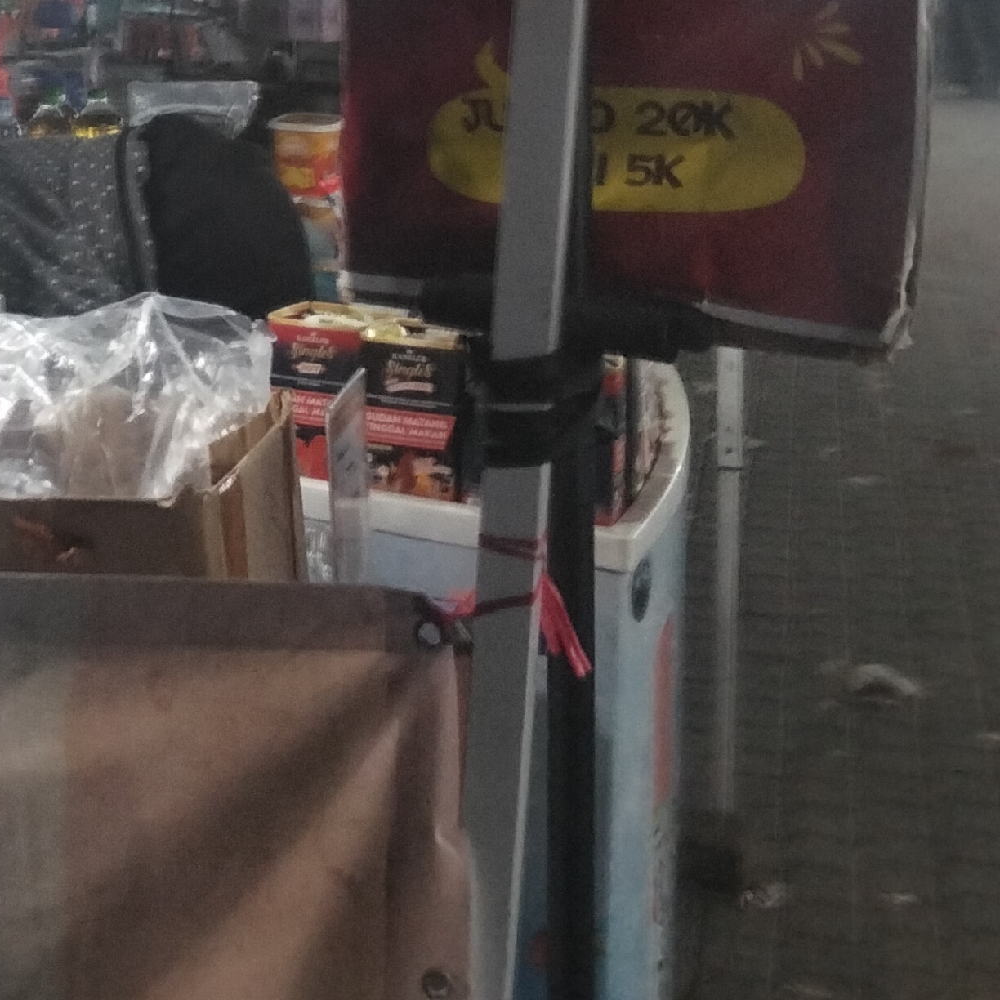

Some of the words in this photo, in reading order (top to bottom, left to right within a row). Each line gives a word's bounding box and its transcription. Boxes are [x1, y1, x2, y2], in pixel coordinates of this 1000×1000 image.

[461, 99, 616, 135] JUO
[634, 99, 736, 142] 20K
[624, 151, 686, 189] 5K
